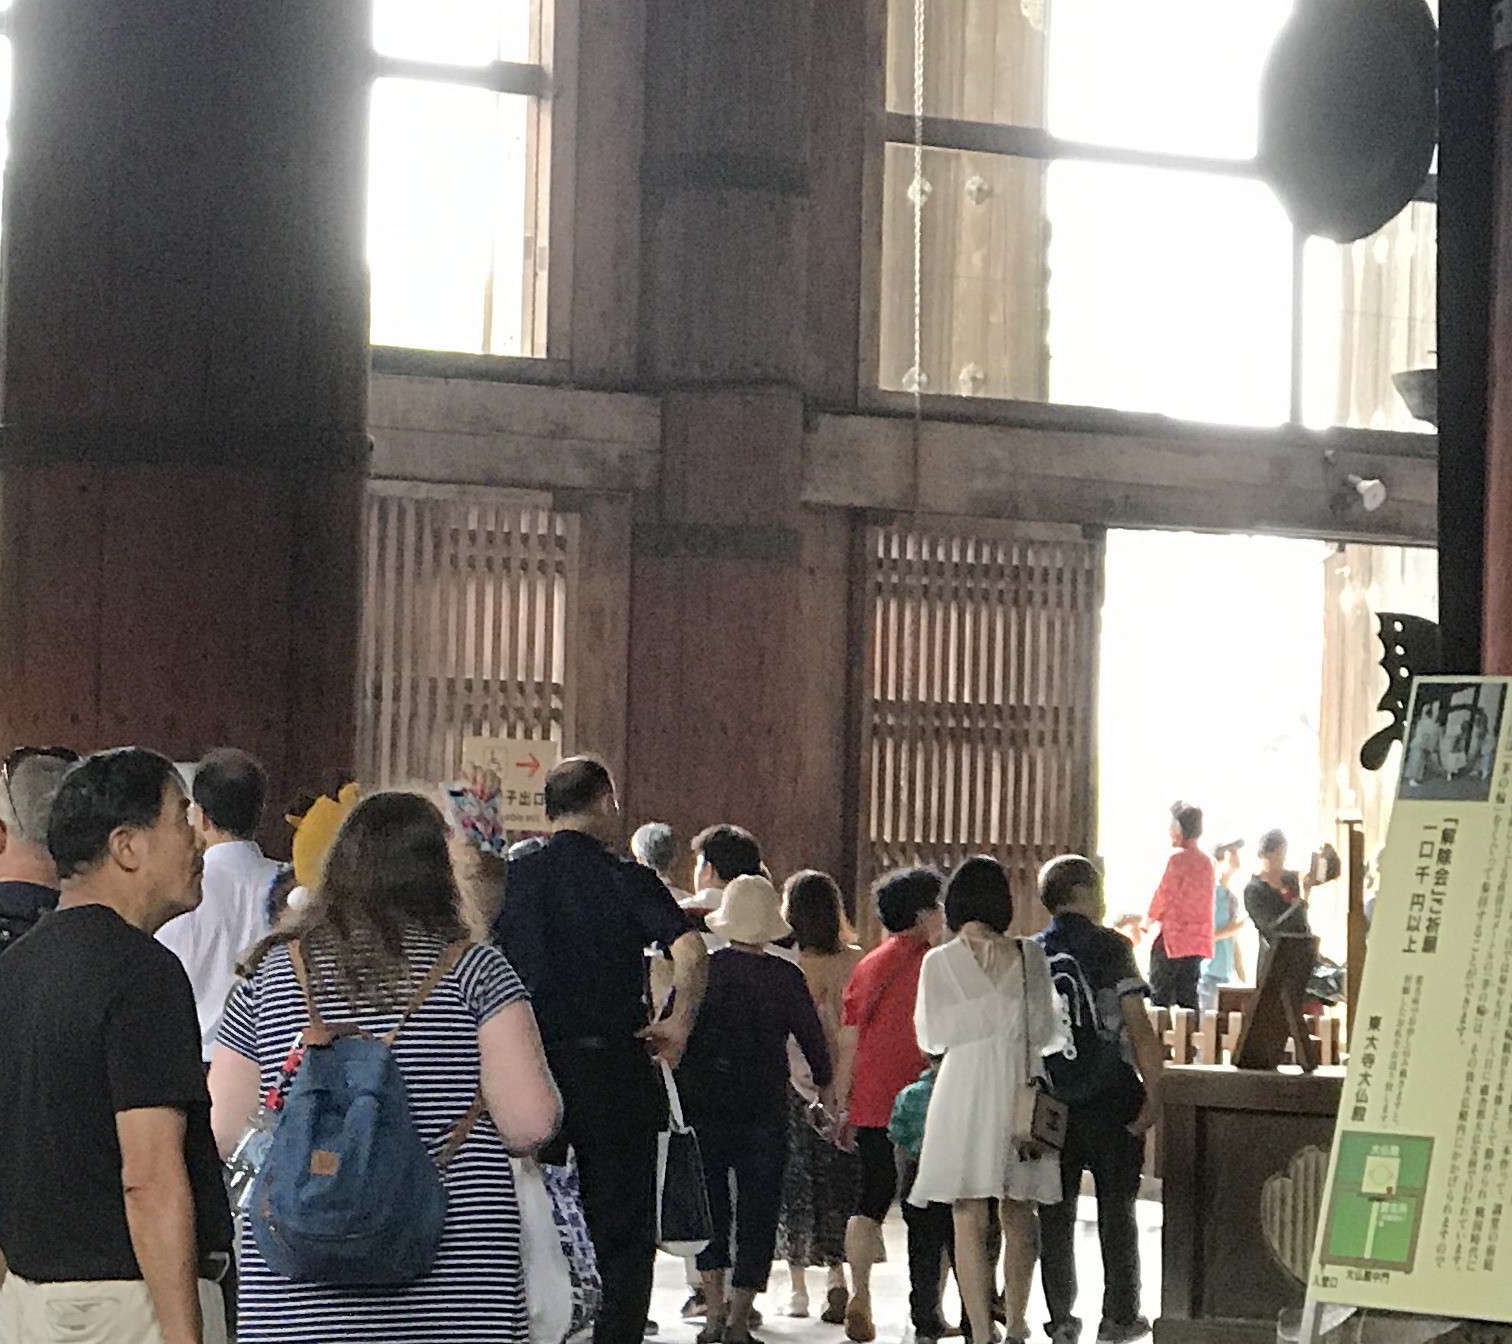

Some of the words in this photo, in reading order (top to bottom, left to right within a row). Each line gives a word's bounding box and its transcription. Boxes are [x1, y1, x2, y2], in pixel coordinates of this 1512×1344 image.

[1351, 1015, 1383, 1122] 東大寺大仏殿
